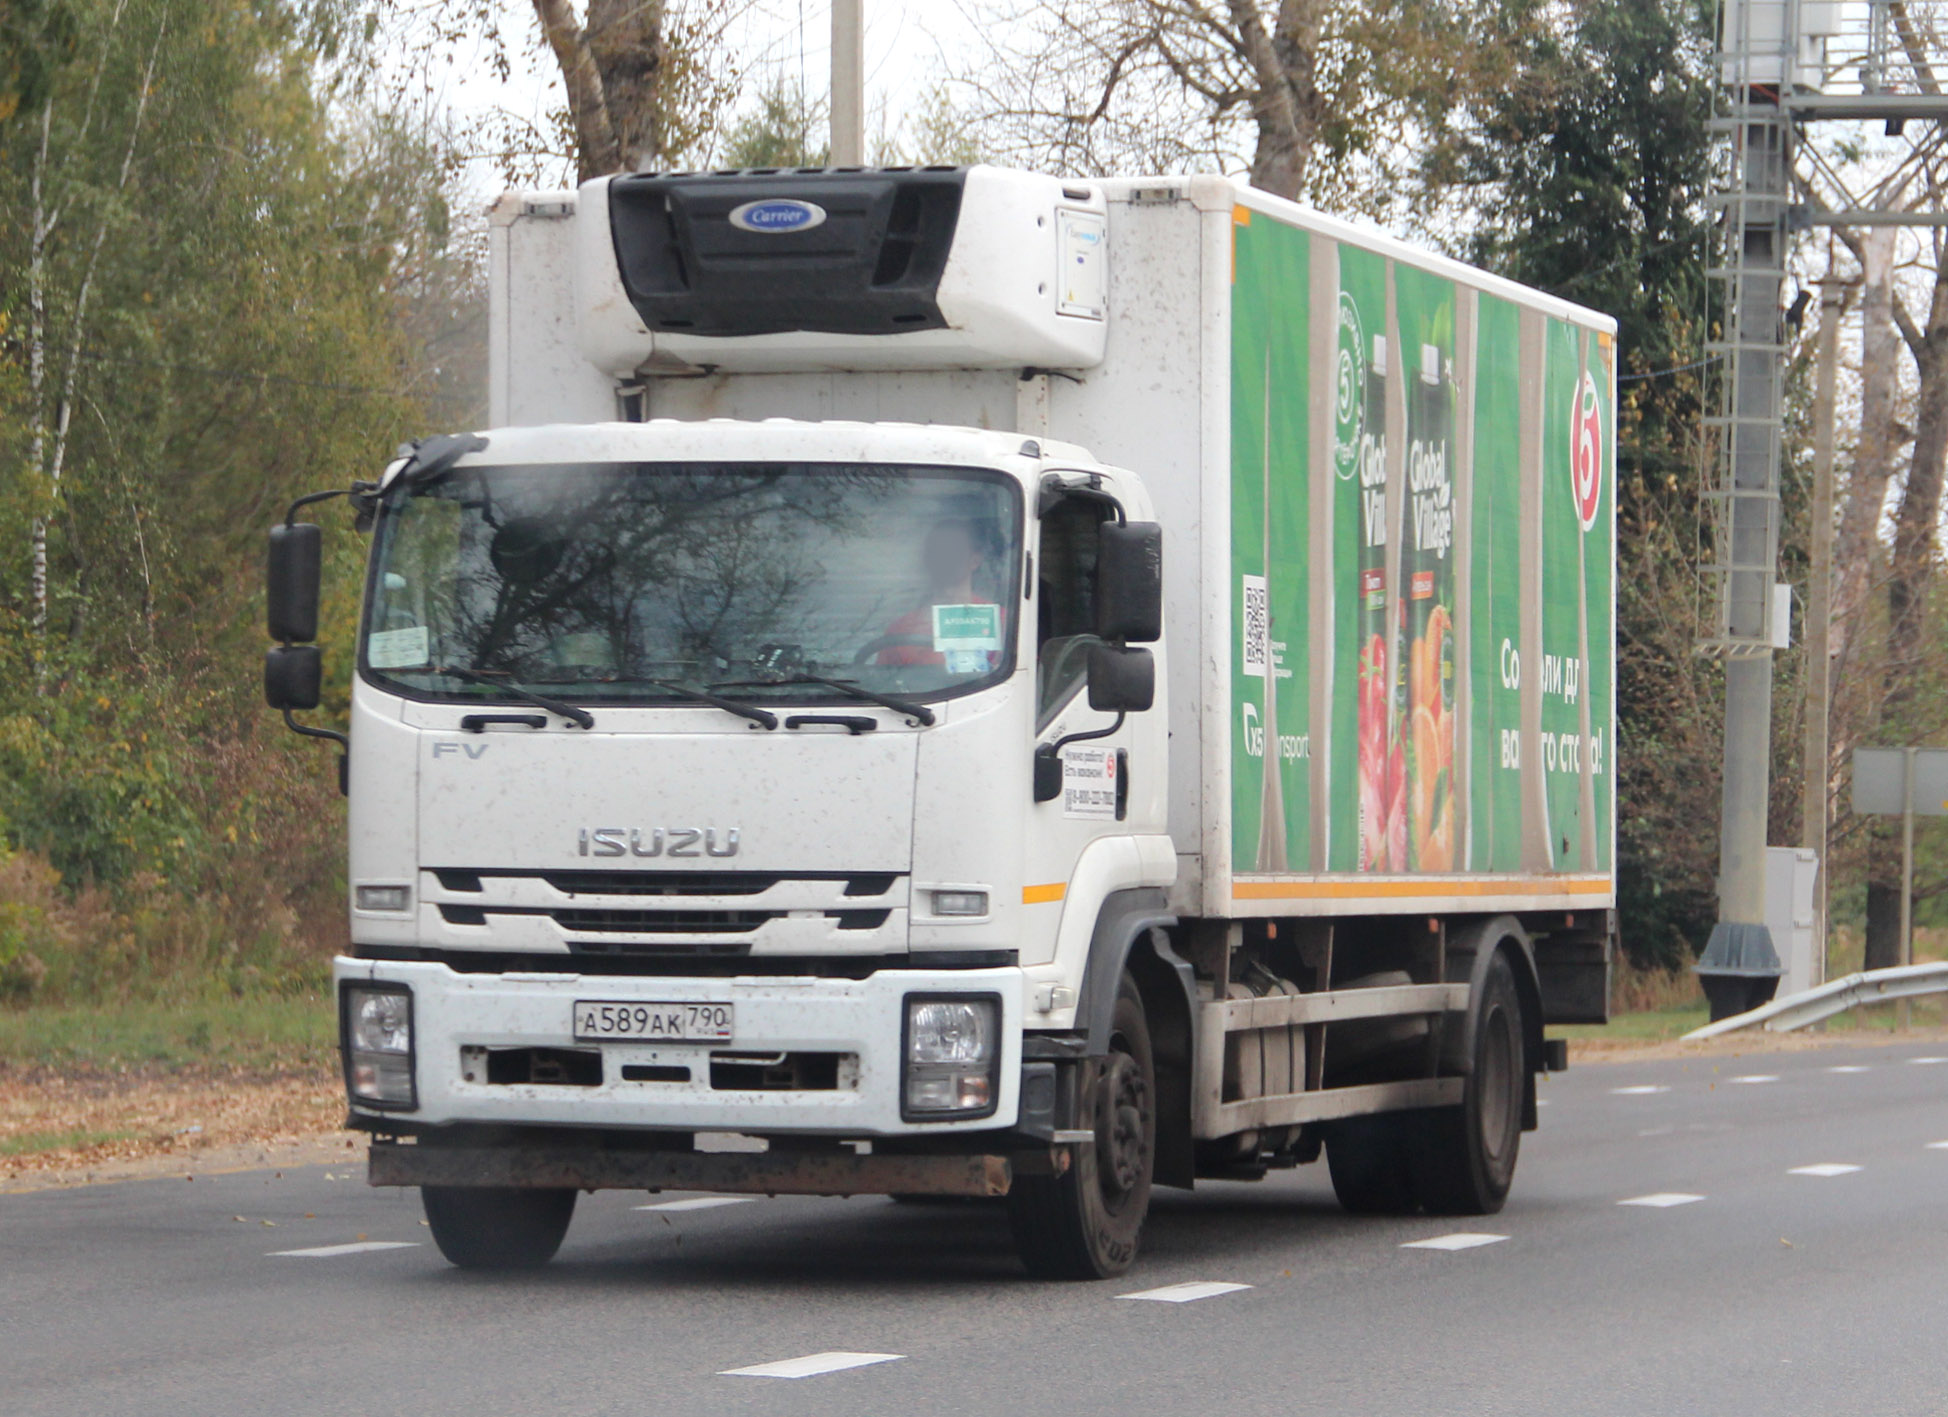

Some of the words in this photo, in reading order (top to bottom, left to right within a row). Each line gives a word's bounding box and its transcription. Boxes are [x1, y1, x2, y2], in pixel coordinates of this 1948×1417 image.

[751, 208, 804, 223] Carrier
[1410, 438, 1446, 493] Global
[1412, 494, 1452, 559] Village
[433, 742, 490, 760] FV
[1501, 728, 1557, 772] ваго
[578, 827, 740, 858] ISUZU
[584, 1007, 681, 1034] А589АК
[687, 1007, 726, 1027] 790
